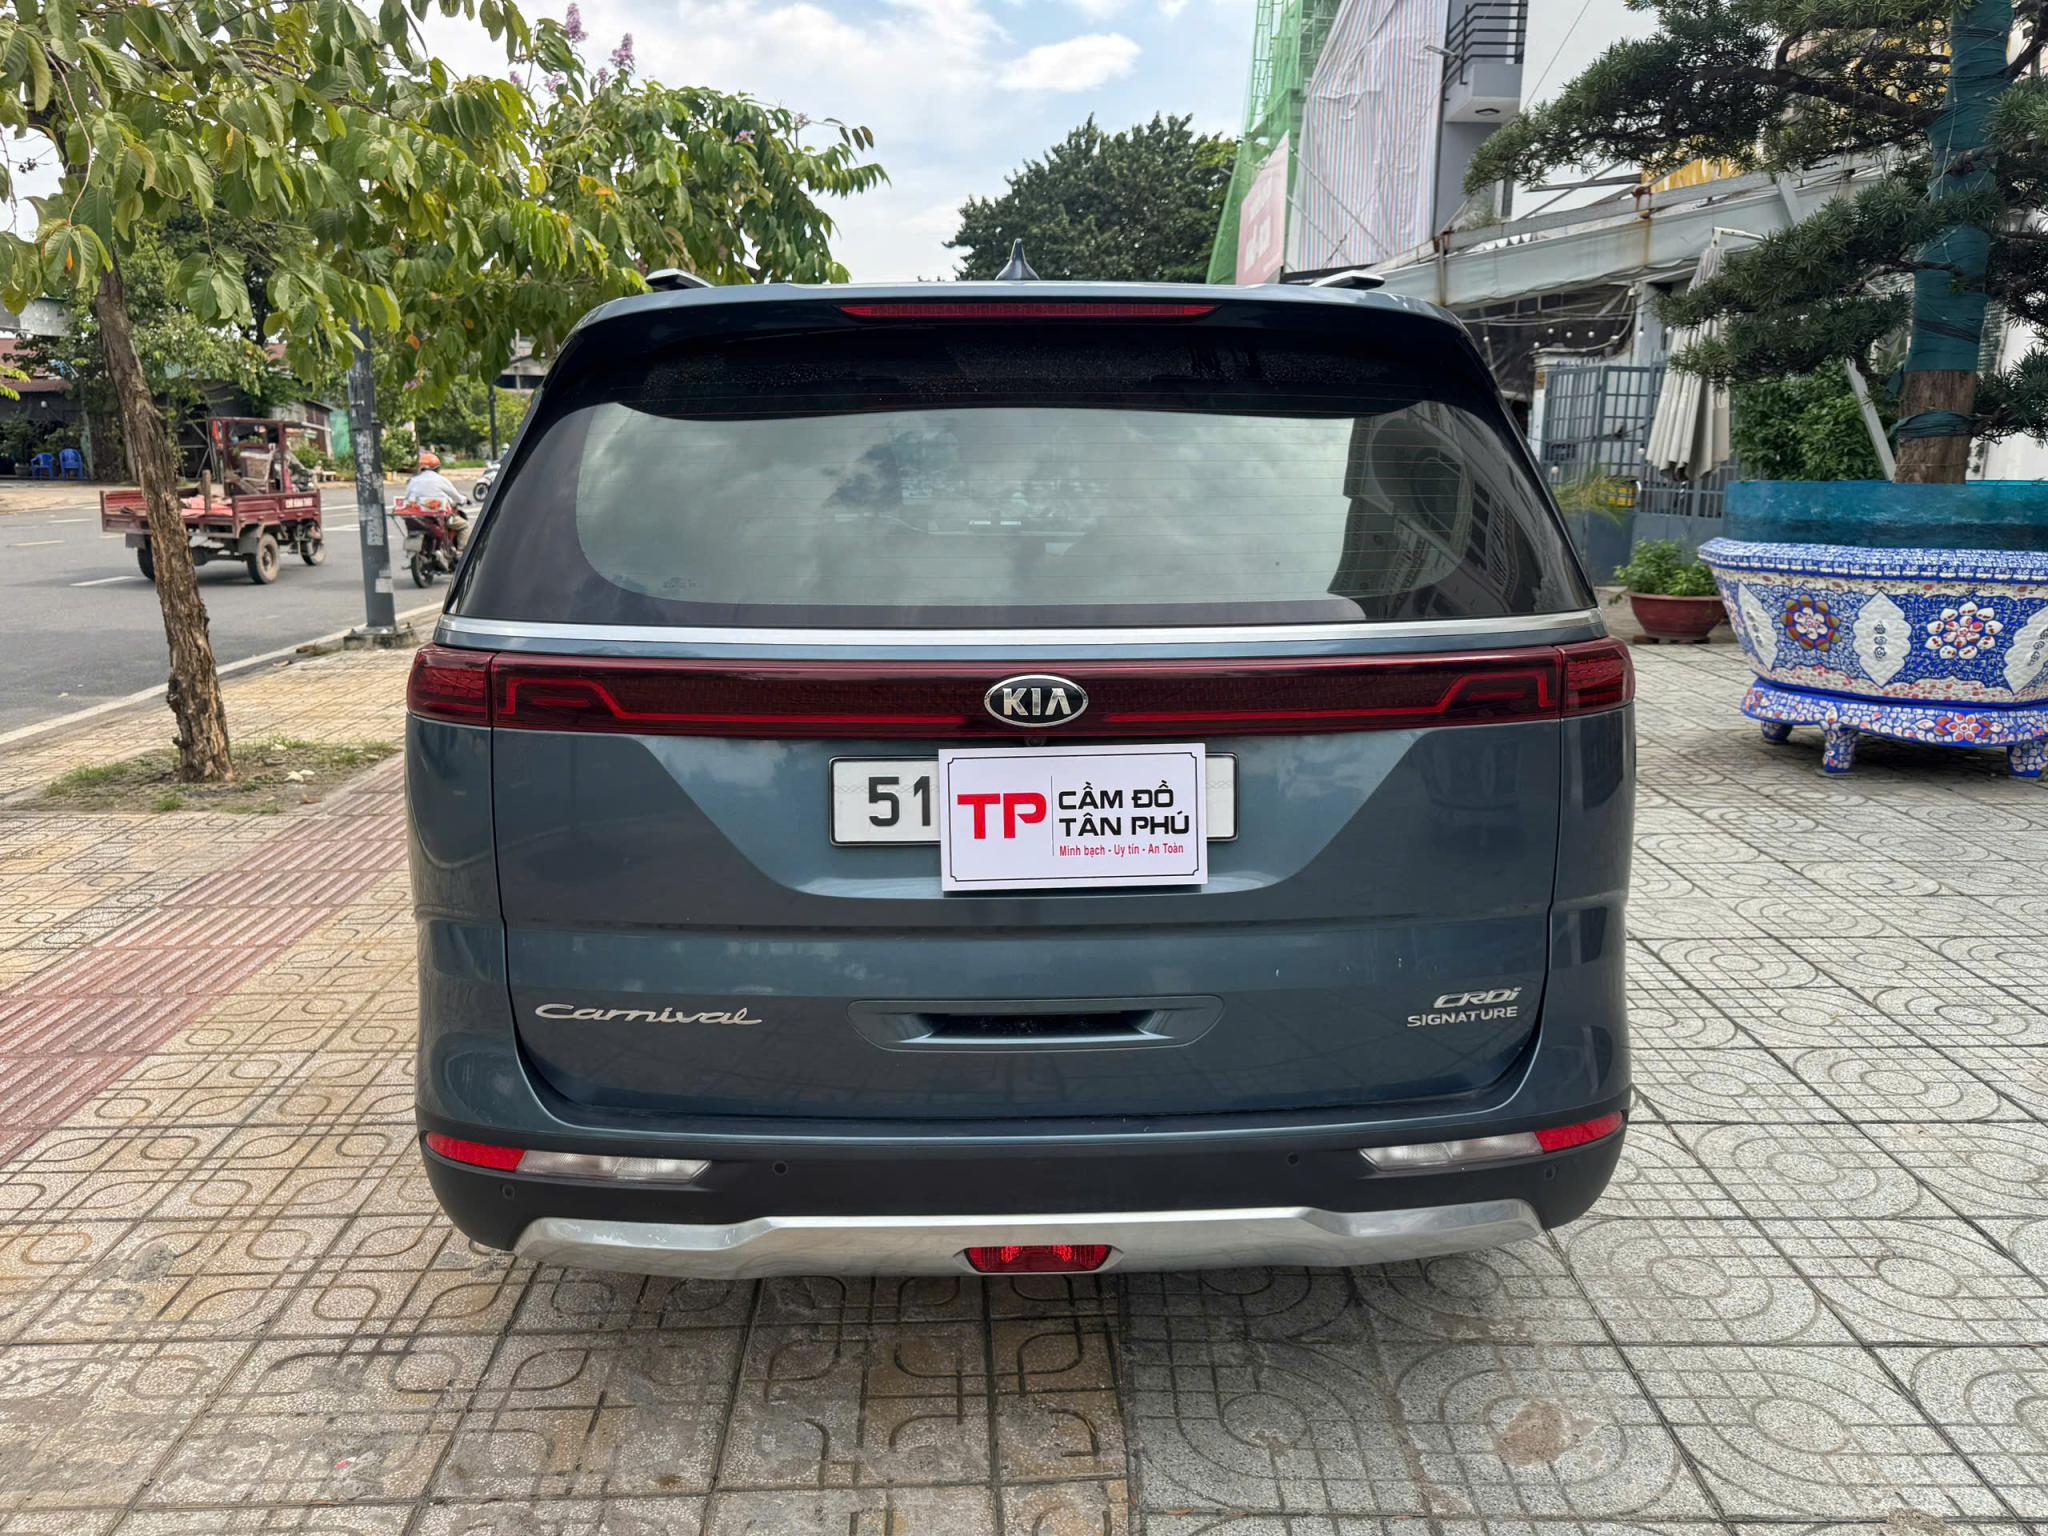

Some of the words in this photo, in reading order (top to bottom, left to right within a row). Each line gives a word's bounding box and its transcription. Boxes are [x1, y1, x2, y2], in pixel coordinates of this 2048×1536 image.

[1003, 687, 1072, 716] KIA
[868, 776, 931, 827] 51
[1058, 781, 1123, 810] CẦM
[1131, 780, 1174, 808] ĐỒ
[957, 792, 1047, 839] TP
[1058, 812, 1122, 837] TÂN
[1131, 811, 1189, 835] PHÚ
[1059, 845, 1081, 856] Minh
[1084, 845, 1105, 857] bạch
[1114, 844, 1125, 857] Uy
[1128, 844, 1140, 854] tín
[1148, 844, 1160, 854] An
[1163, 843, 1184, 854] Toàn
[1433, 987, 1522, 1008] CRDi
[535, 1003, 762, 1025] Carnival
[1407, 1006, 1518, 1027] SIGNATURE
